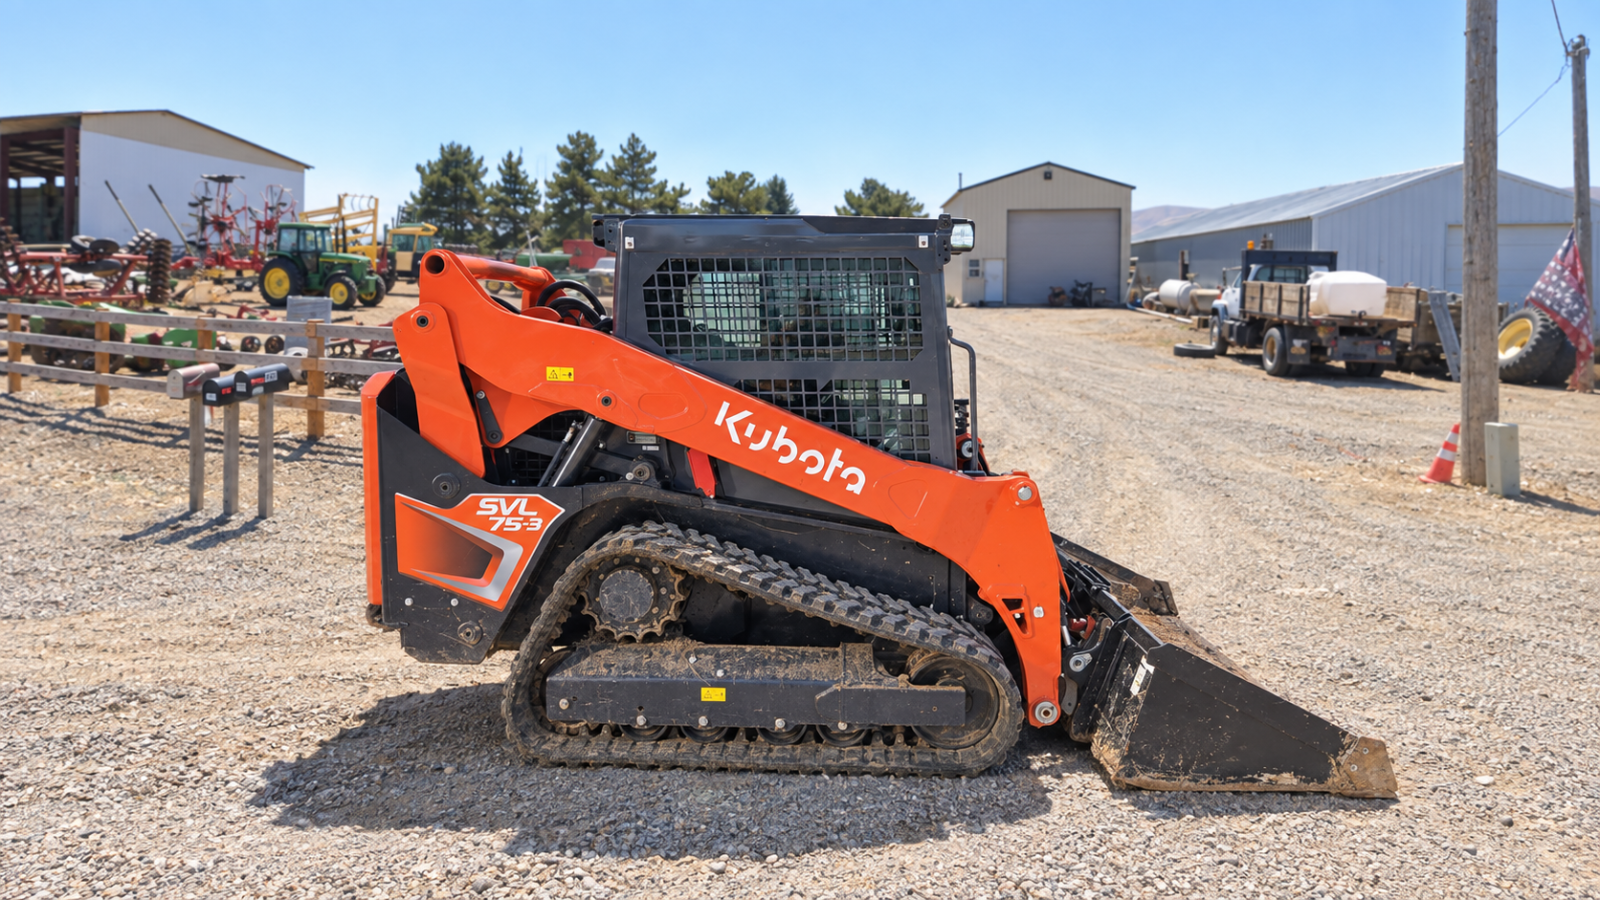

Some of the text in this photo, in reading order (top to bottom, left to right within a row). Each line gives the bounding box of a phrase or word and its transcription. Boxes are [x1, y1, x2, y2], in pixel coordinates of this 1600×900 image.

[714, 400, 866, 495] Kubota
[476, 498, 538, 516] SVL
[489, 516, 543, 531] 75-3
